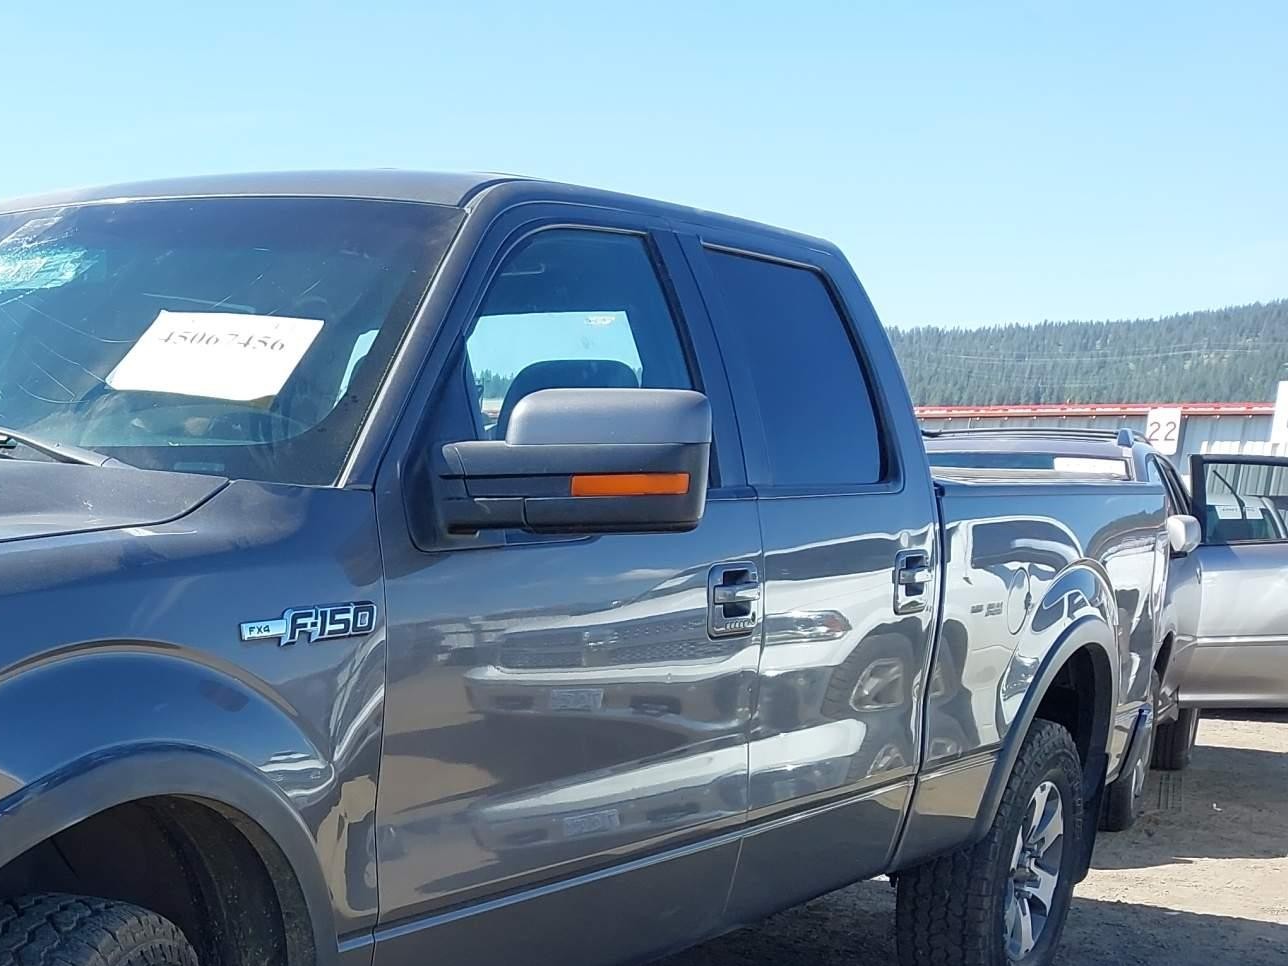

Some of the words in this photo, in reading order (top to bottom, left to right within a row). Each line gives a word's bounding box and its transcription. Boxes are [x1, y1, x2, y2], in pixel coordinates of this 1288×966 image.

[1147, 420, 1178, 441] 22
[248, 625, 271, 636] FX4
[283, 603, 377, 644] F-150
